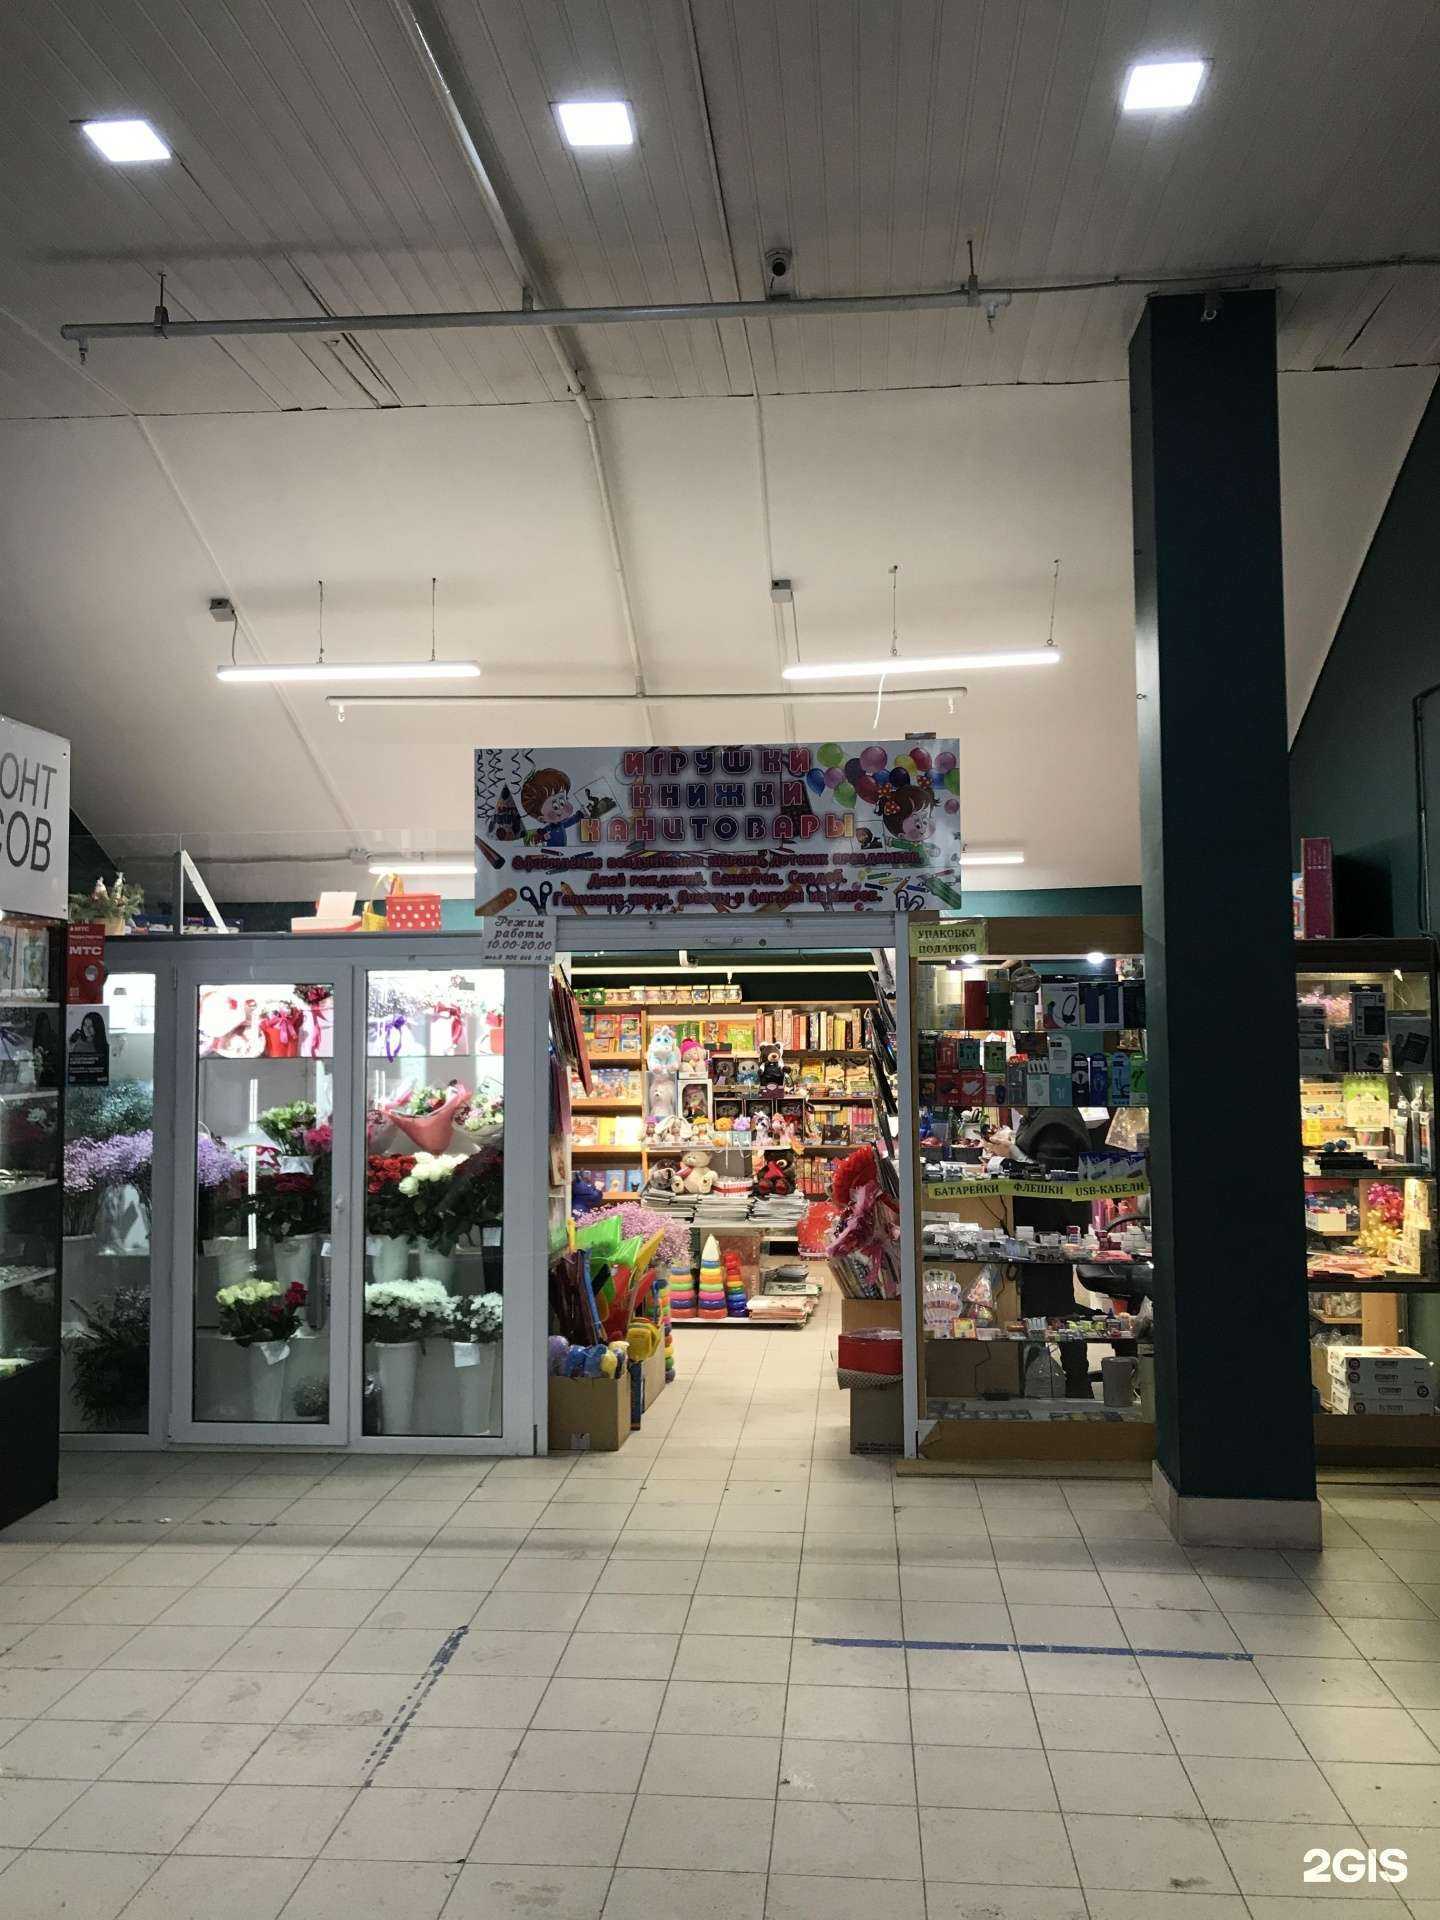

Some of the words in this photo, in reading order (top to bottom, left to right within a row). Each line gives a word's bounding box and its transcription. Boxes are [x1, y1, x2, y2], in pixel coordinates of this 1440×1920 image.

[623, 747, 811, 776] ИГРУШКИ
[631, 780, 804, 809] КНИЖКИ
[579, 813, 854, 842] КАНЦТОВАРЫ
[494, 915, 545, 928] Режим
[494, 927, 544, 940] работы
[918, 928, 976, 939] УПАКОВКА
[69, 945, 102, 955] МТС
[919, 943, 977, 954] ПОДАРКОВ
[934, 1183, 999, 1197] БАТАРЕЙКИ
[1013, 1183, 1064, 1195] ФЛЕШКИ
[1075, 1181, 1145, 1197] USB-КАБЕЛИ
